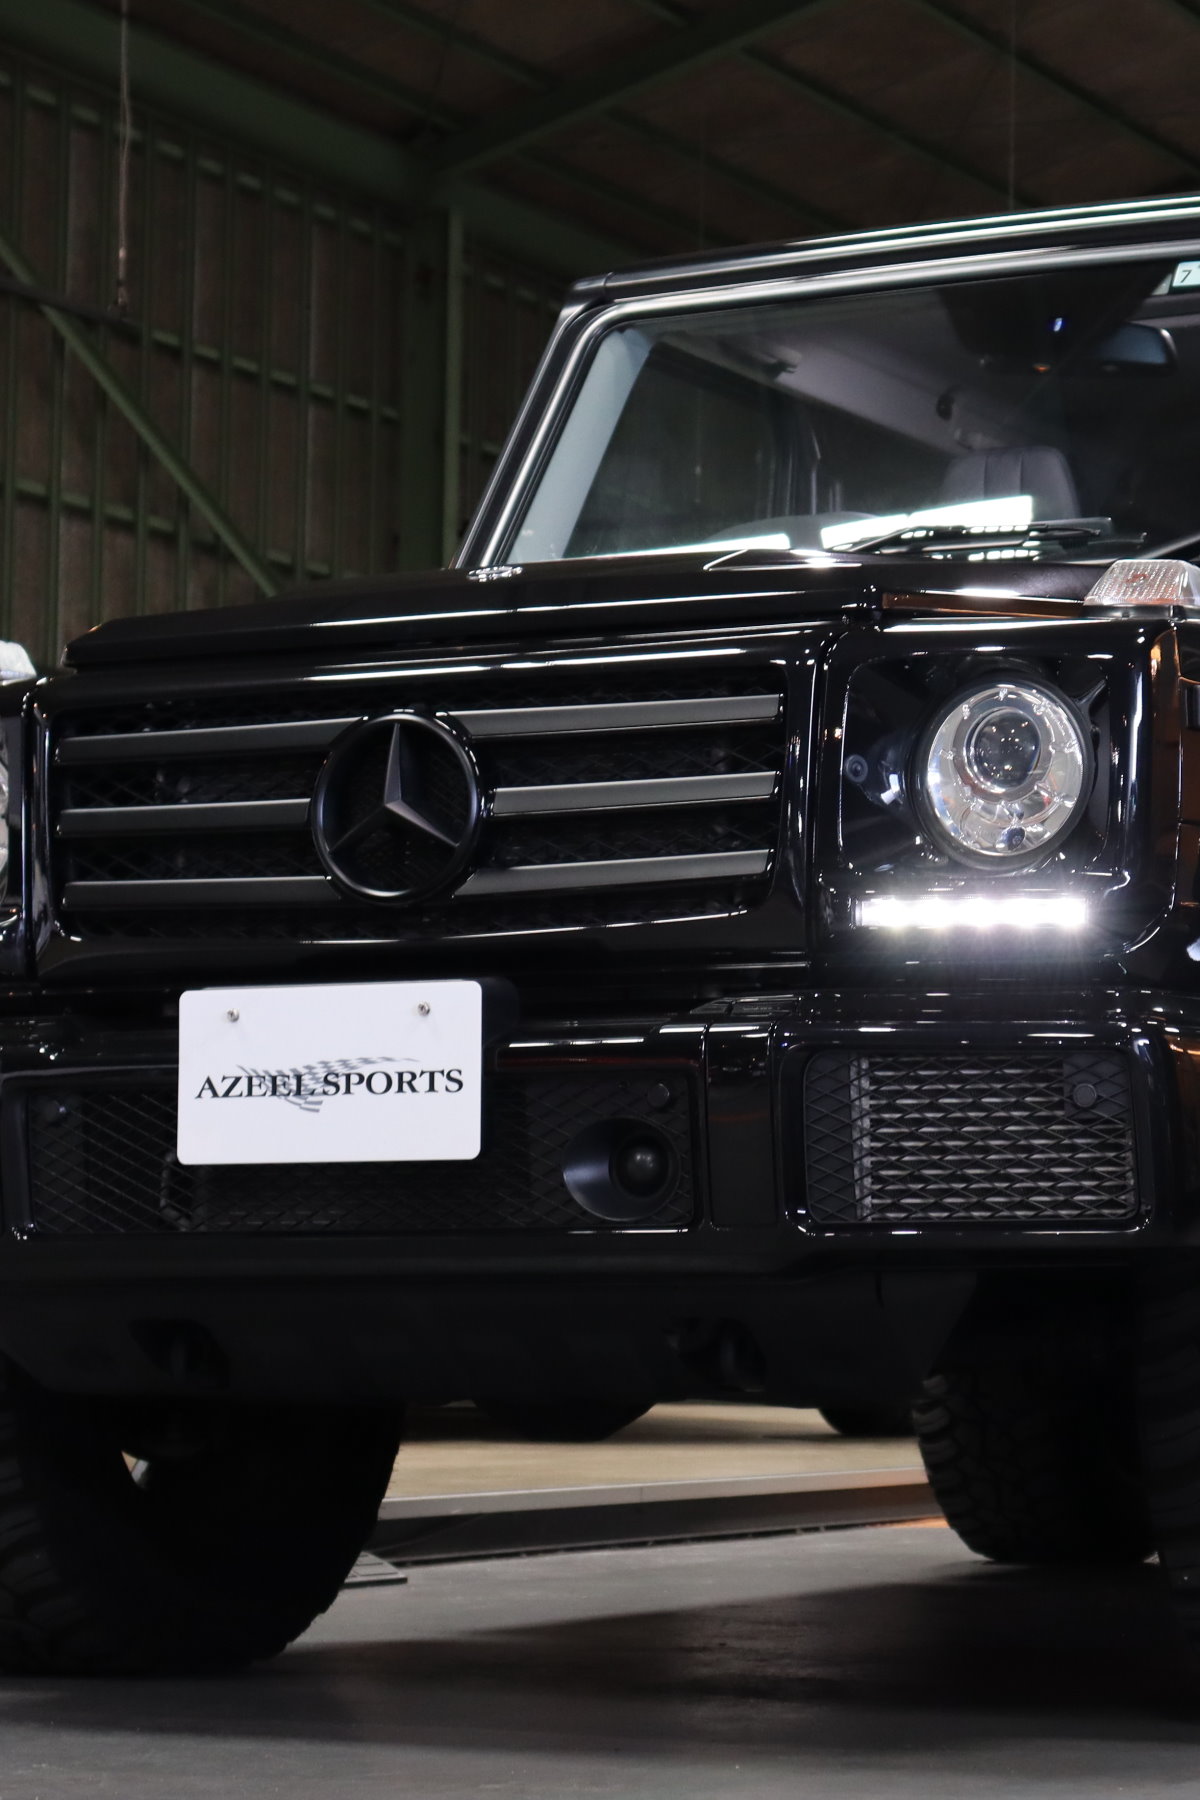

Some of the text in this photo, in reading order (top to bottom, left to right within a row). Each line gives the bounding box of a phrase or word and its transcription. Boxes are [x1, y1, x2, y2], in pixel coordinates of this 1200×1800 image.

[1180, 269, 1192, 283] 7
[195, 1069, 464, 1099] AZEEL SPORTS
